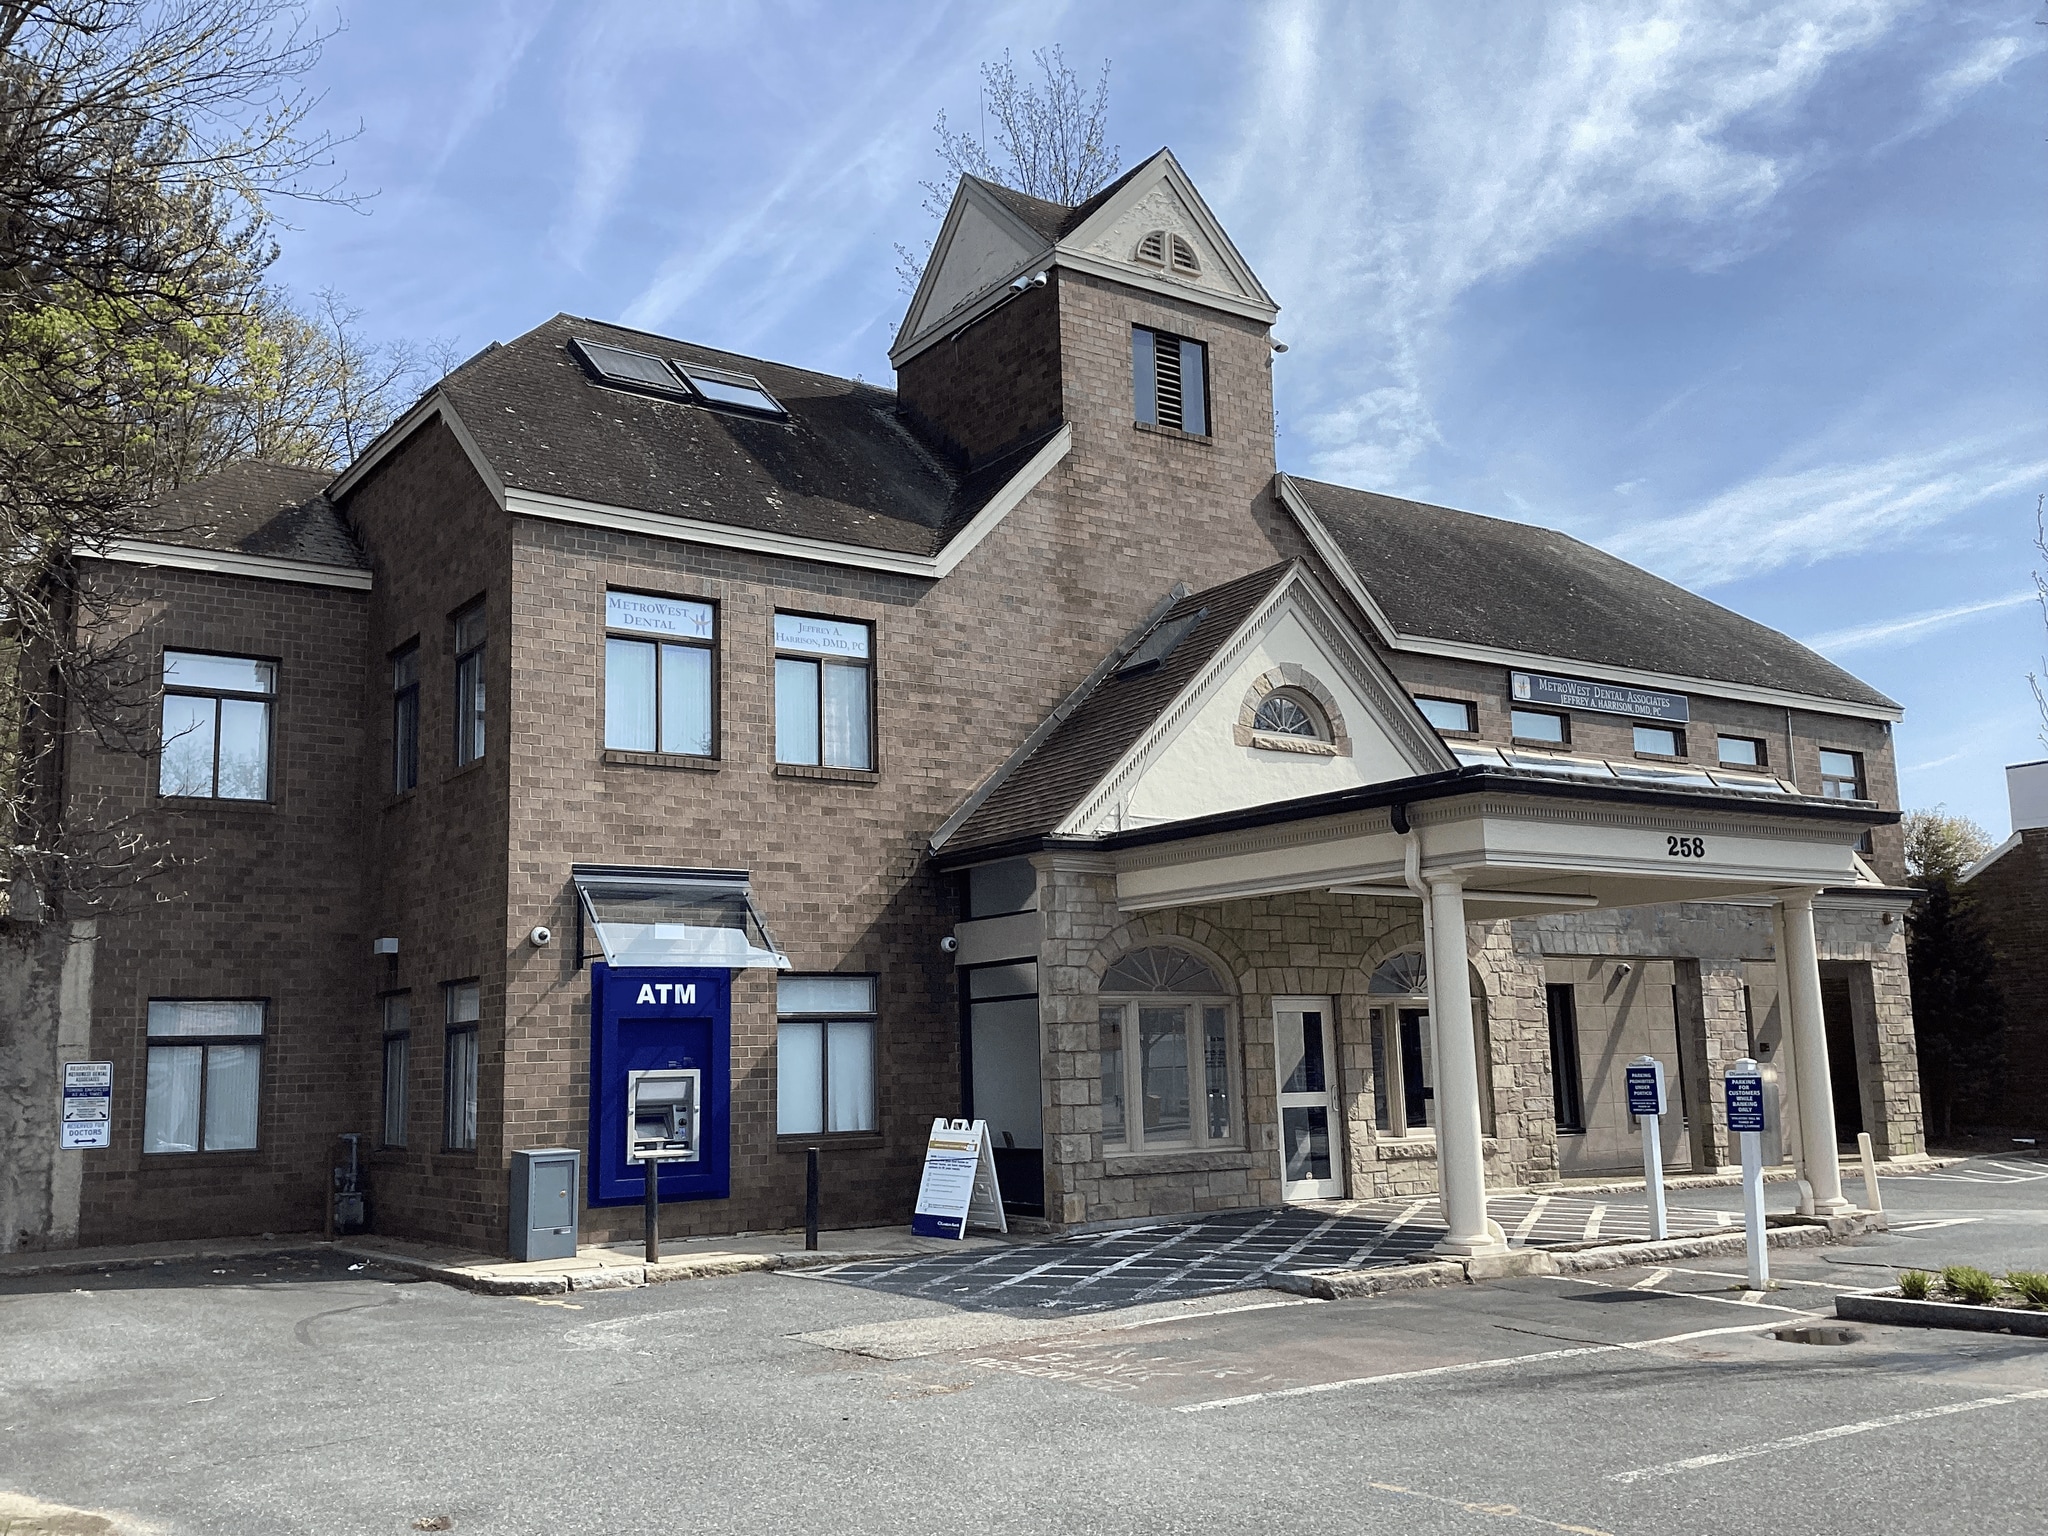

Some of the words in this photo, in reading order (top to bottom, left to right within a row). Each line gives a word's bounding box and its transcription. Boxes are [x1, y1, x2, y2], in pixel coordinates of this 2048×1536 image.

[822, 638, 850, 651] DMD,
[852, 642, 865, 652] PC
[1560, 694, 1589, 706] JEFFREY
[1653, 708, 1662, 716] PC
[1667, 836, 1705, 858] 258
[636, 983, 696, 1005] ATM
[958, 1356, 1140, 1393] RESERVED
